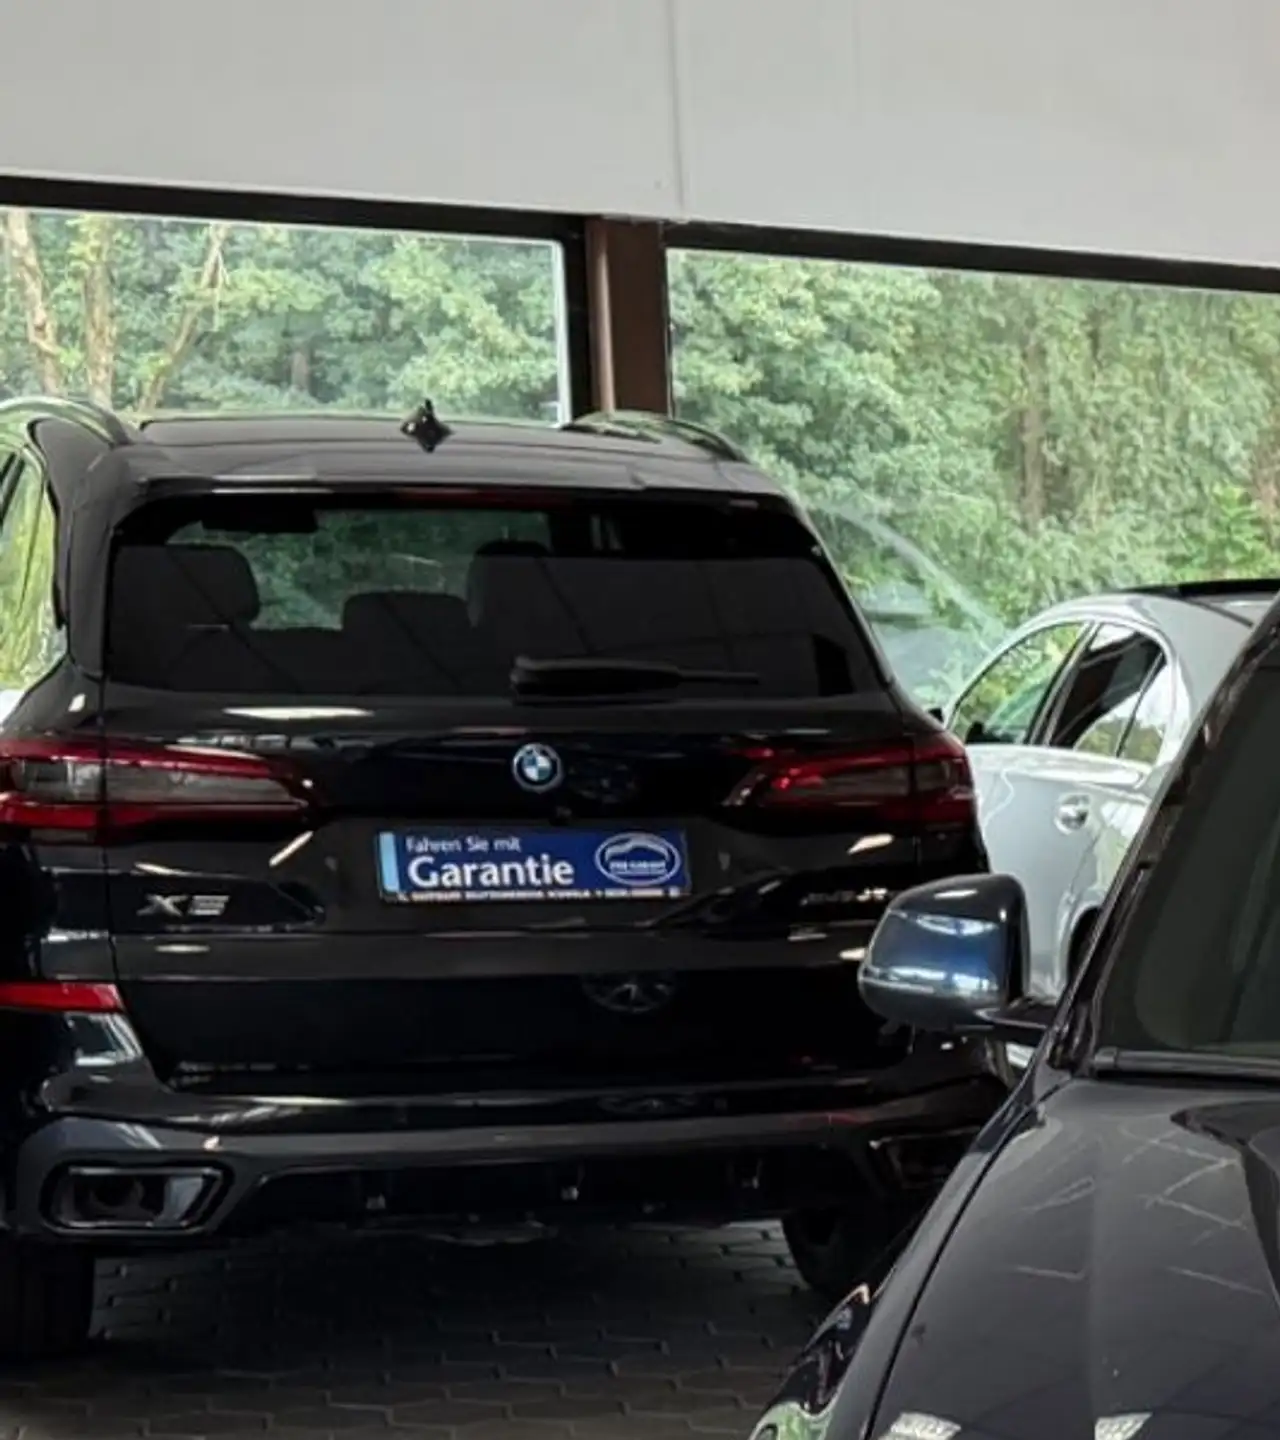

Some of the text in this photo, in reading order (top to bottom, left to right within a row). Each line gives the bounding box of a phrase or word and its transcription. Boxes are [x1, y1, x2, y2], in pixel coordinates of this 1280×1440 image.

[404, 835, 521, 852] Fahren Sie mit
[407, 852, 575, 888] Garantie
